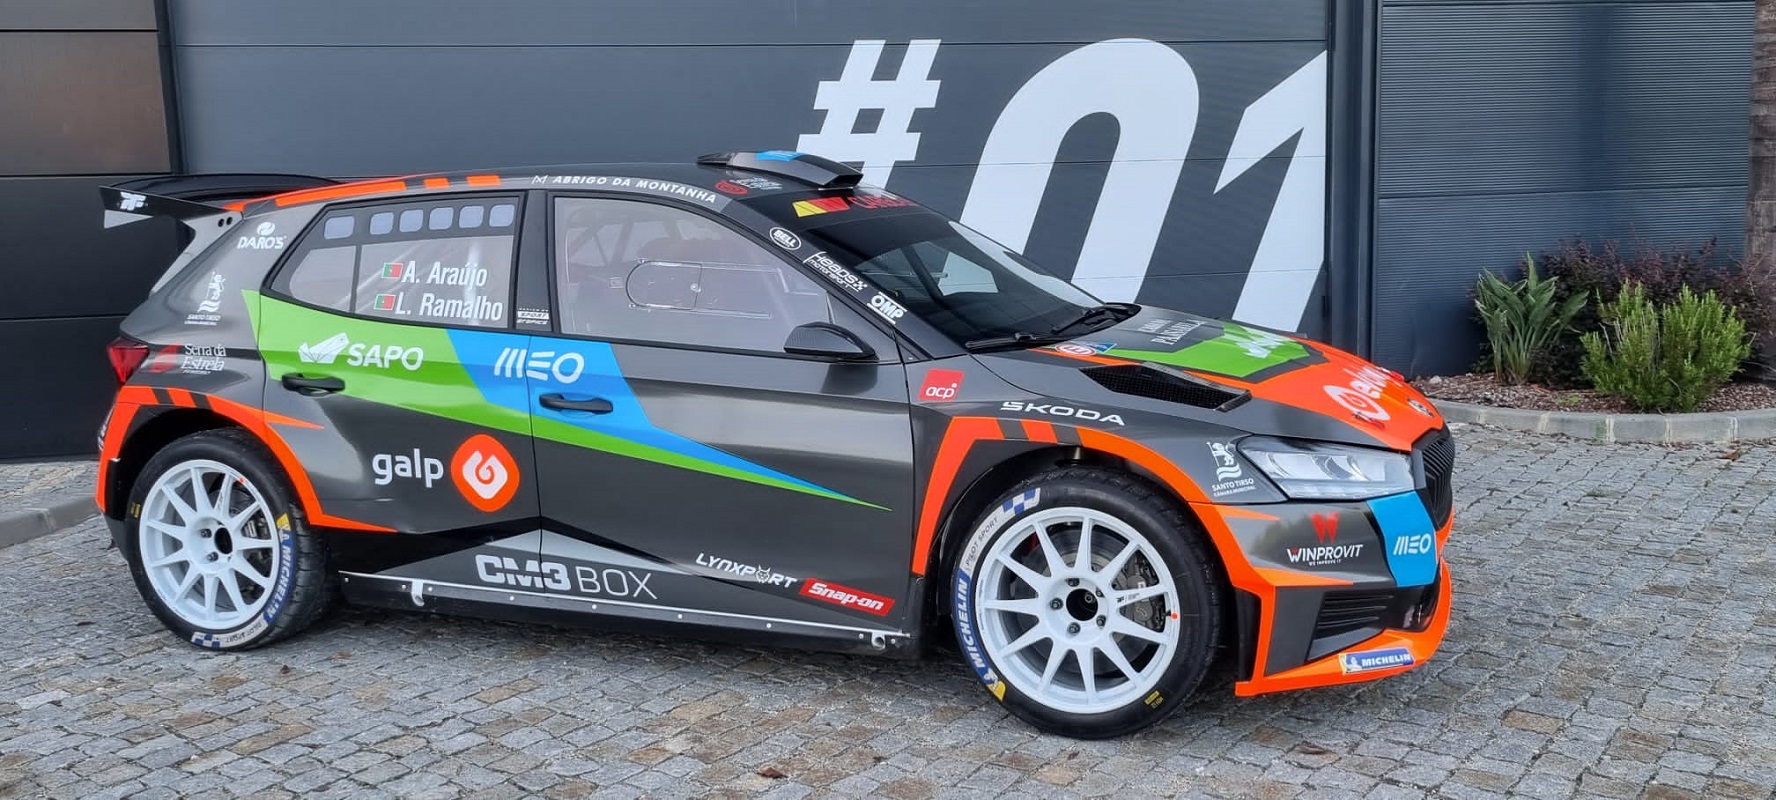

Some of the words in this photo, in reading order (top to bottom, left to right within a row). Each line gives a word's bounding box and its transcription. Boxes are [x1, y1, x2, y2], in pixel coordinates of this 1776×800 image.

[552, 175, 607, 185] ABRIGO
[611, 177, 631, 187] DA
[635, 180, 717, 204] MONTANHA
[773, 230, 796, 247] BELL
[401, 261, 420, 284] A.
[426, 261, 488, 290] Araújo
[395, 292, 411, 315] L.
[419, 293, 503, 321] Ramalho
[870, 294, 904, 319] OMP
[347, 343, 424, 371] SAPO
[493, 347, 585, 384] MEO
[925, 385, 957, 399] acp
[372, 448, 444, 488] galp
[1212, 480, 1235, 492] SANTO
[1234, 477, 1255, 488] TIRSO
[978, 517, 999, 541] SPORT
[1286, 544, 1364, 563] WINPROVIT
[1393, 533, 1431, 556] MEO
[266, 544, 292, 619] MICHELIN
[475, 554, 572, 591] CM3
[575, 566, 658, 600] BOX
[808, 582, 885, 611] Snap-on
[957, 578, 986, 669] MICHELIN
[1360, 653, 1412, 667] MICHELIN
